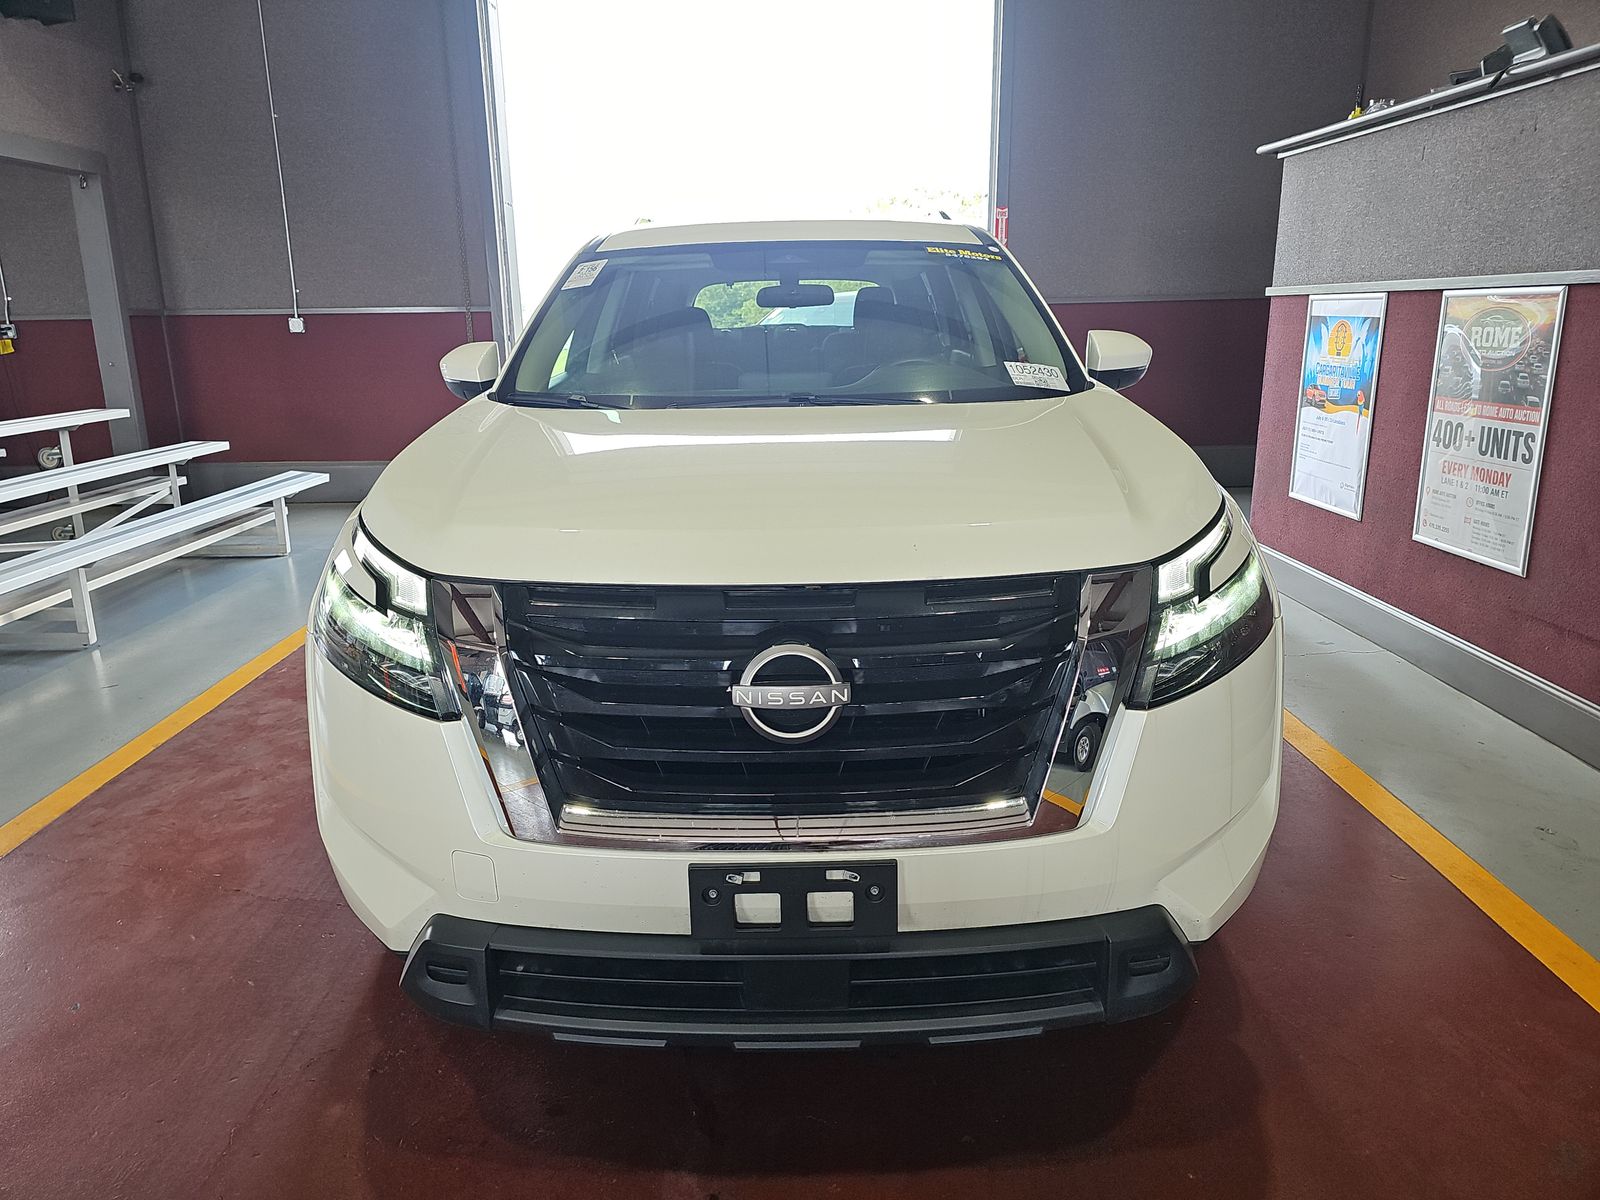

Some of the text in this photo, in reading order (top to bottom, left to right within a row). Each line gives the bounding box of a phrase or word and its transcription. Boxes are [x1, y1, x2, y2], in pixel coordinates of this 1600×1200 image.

[926, 246, 1002, 260] Elite Motors
[1470, 326, 1523, 348] ROME
[1009, 364, 1059, 378] 1052430
[1482, 405, 1498, 417] ROME
[1498, 406, 1514, 419] AUTO
[1514, 408, 1540, 423] AUCTION
[1432, 419, 1536, 465] 400+ UNITS
[1441, 460, 1512, 488] EVERY MONDAY
[1441, 477, 1454, 487] LANE
[1464, 482, 1469, 490] 2
[1475, 484, 1490, 495] 11:00
[1490, 487, 1500, 497] AM
[1501, 490, 1509, 499] ET
[735, 688, 848, 705] NISSAN
